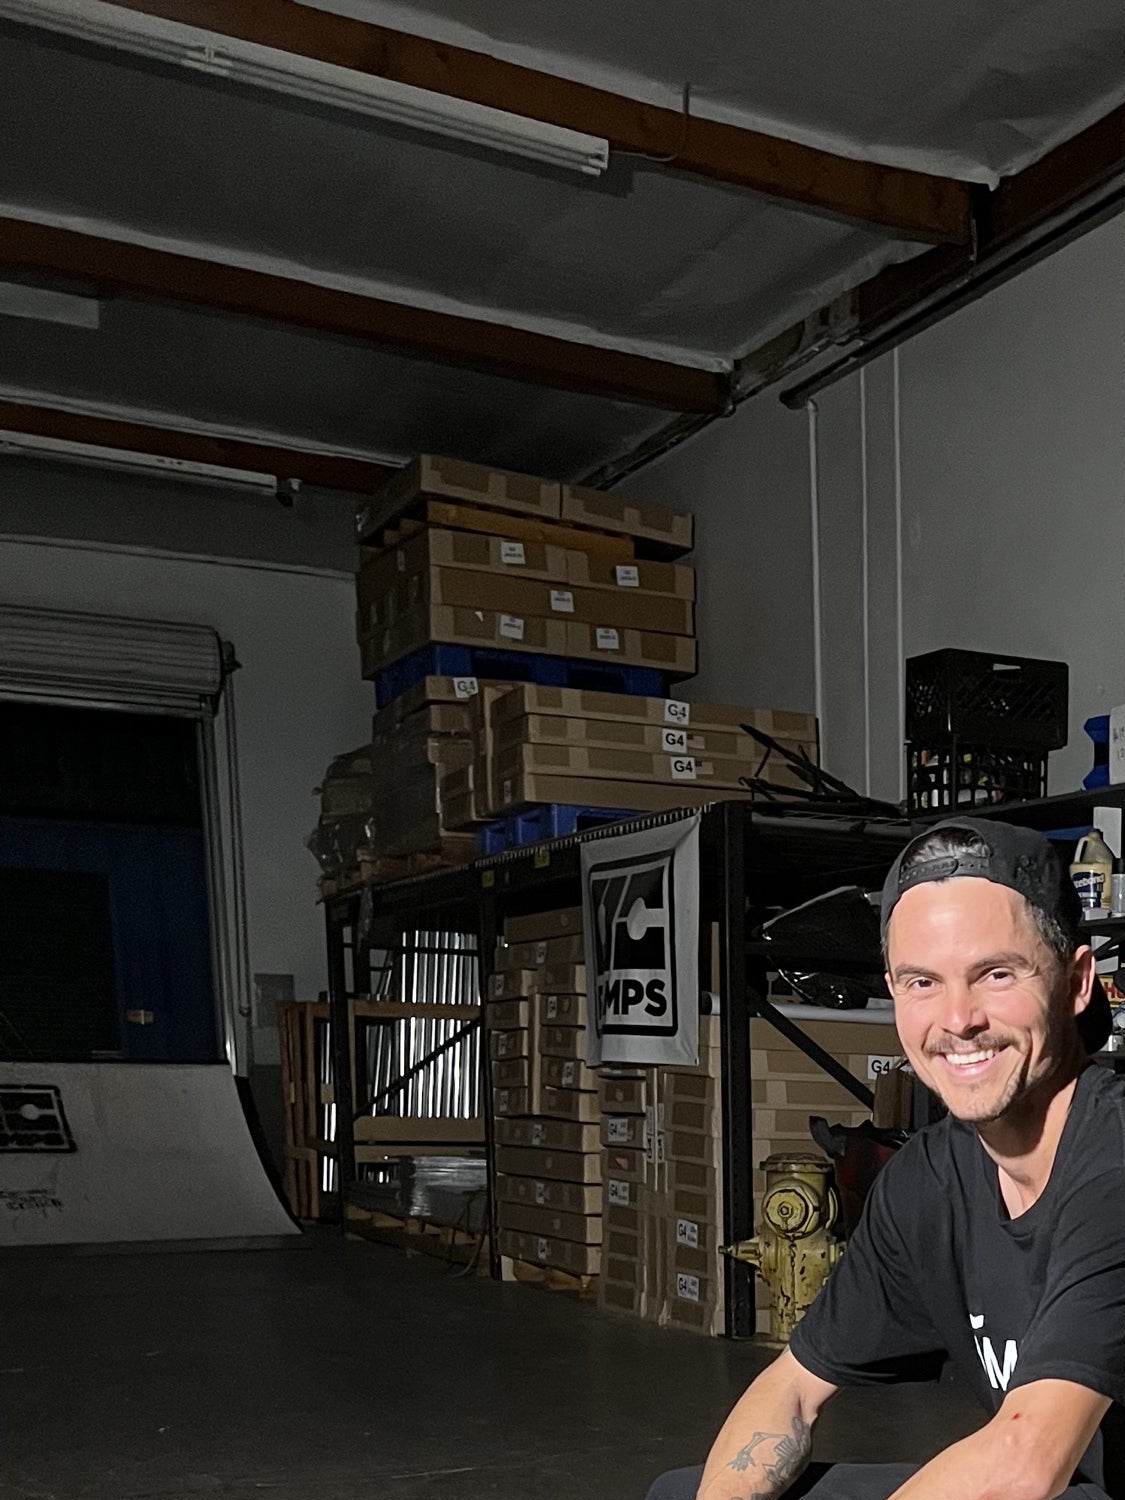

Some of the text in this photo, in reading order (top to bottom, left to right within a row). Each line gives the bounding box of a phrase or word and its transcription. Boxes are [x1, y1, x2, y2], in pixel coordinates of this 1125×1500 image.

[667, 703, 688, 718] G4
[665, 732, 685, 747] G4
[673, 760, 694, 773] G4
[597, 978, 668, 1021] MPS
[871, 1059, 891, 1074] G4
[678, 1223, 688, 1238] G4
[678, 1277, 688, 1292] G4
